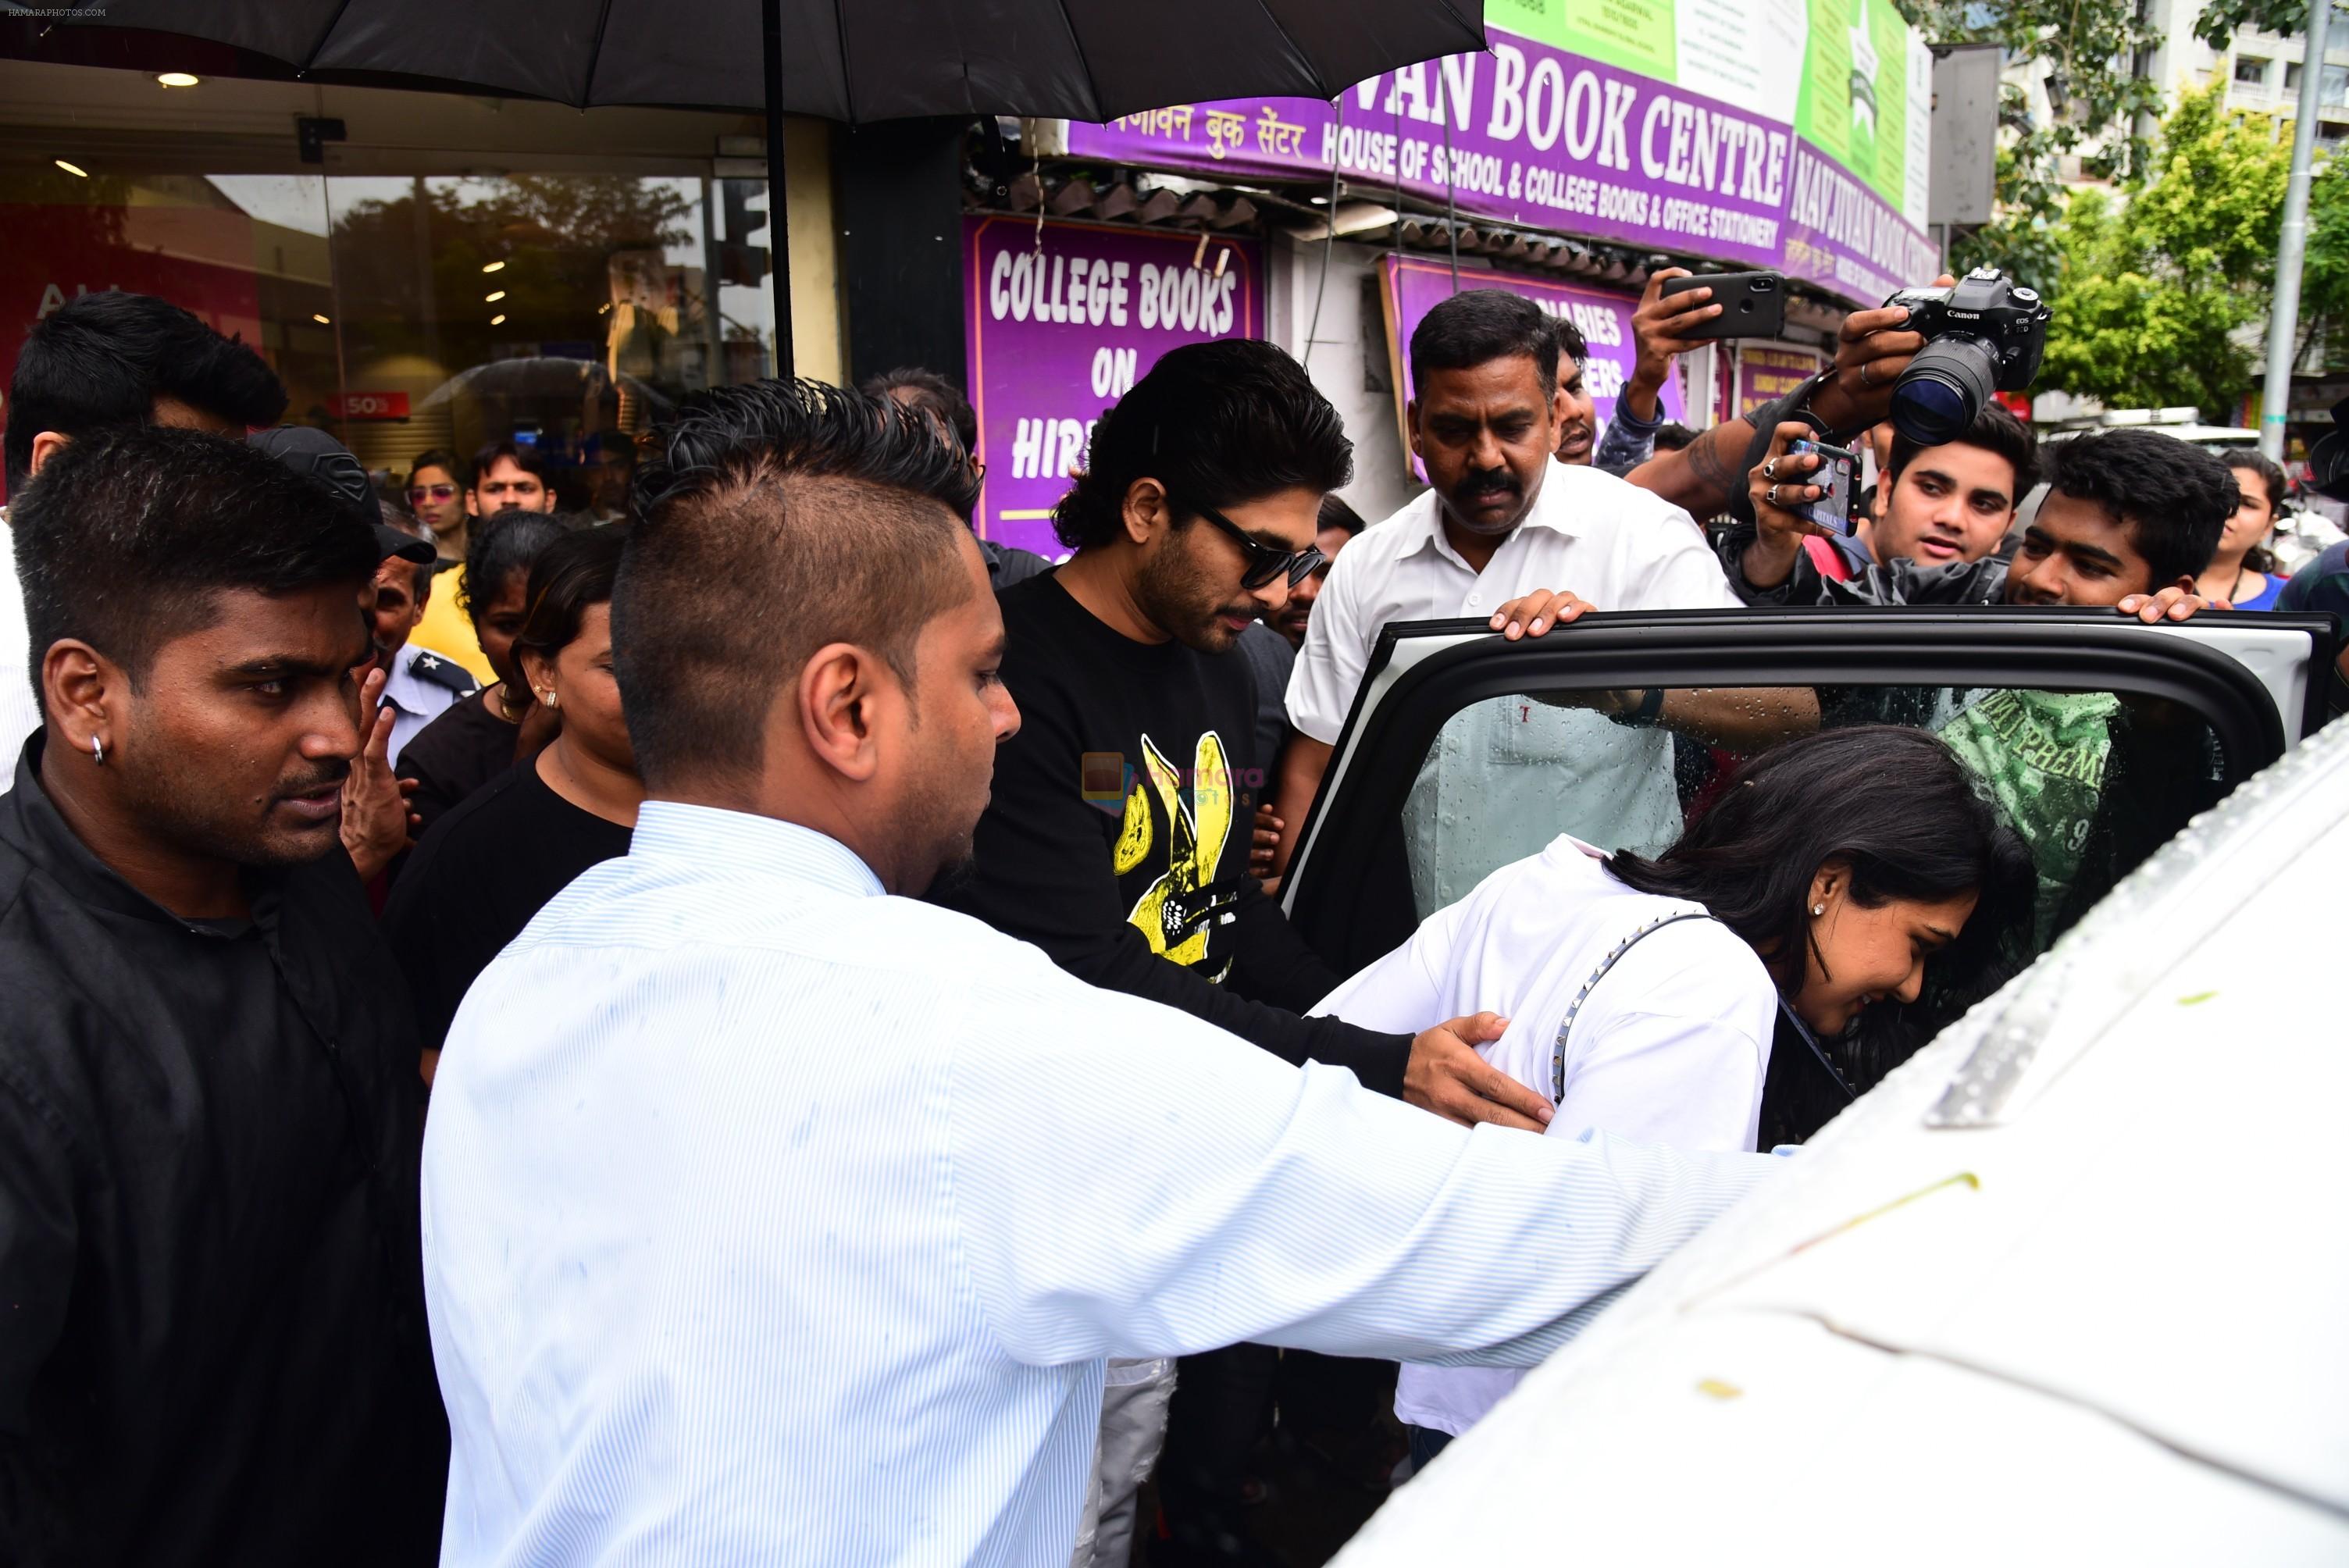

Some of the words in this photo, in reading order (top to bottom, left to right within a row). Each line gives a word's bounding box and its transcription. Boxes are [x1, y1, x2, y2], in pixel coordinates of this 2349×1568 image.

[1206, 109, 1247, 160] बुक
[1256, 105, 1306, 160] सेंटर
[1487, 42, 1638, 171] BOOK
[1641, 94, 1788, 208] CENTRE
[1321, 122, 1398, 176] HOUSE
[1400, 137, 1430, 180] OF
[1431, 144, 1505, 197] SCHOOL
[1507, 161, 1522, 200] &
[1525, 165, 1599, 216] COLLEGE
[1597, 182, 1650, 226] BOOKS
[1649, 194, 1662, 229] &
[1663, 197, 1711, 237] OFFICE
[1709, 205, 1780, 251] STATIONERY
[990, 249, 1130, 327] COLLEGE
[1139, 262, 1237, 338] BOOKS
[1947, 309, 1980, 320] Canon
[1091, 347, 1138, 398] ON
